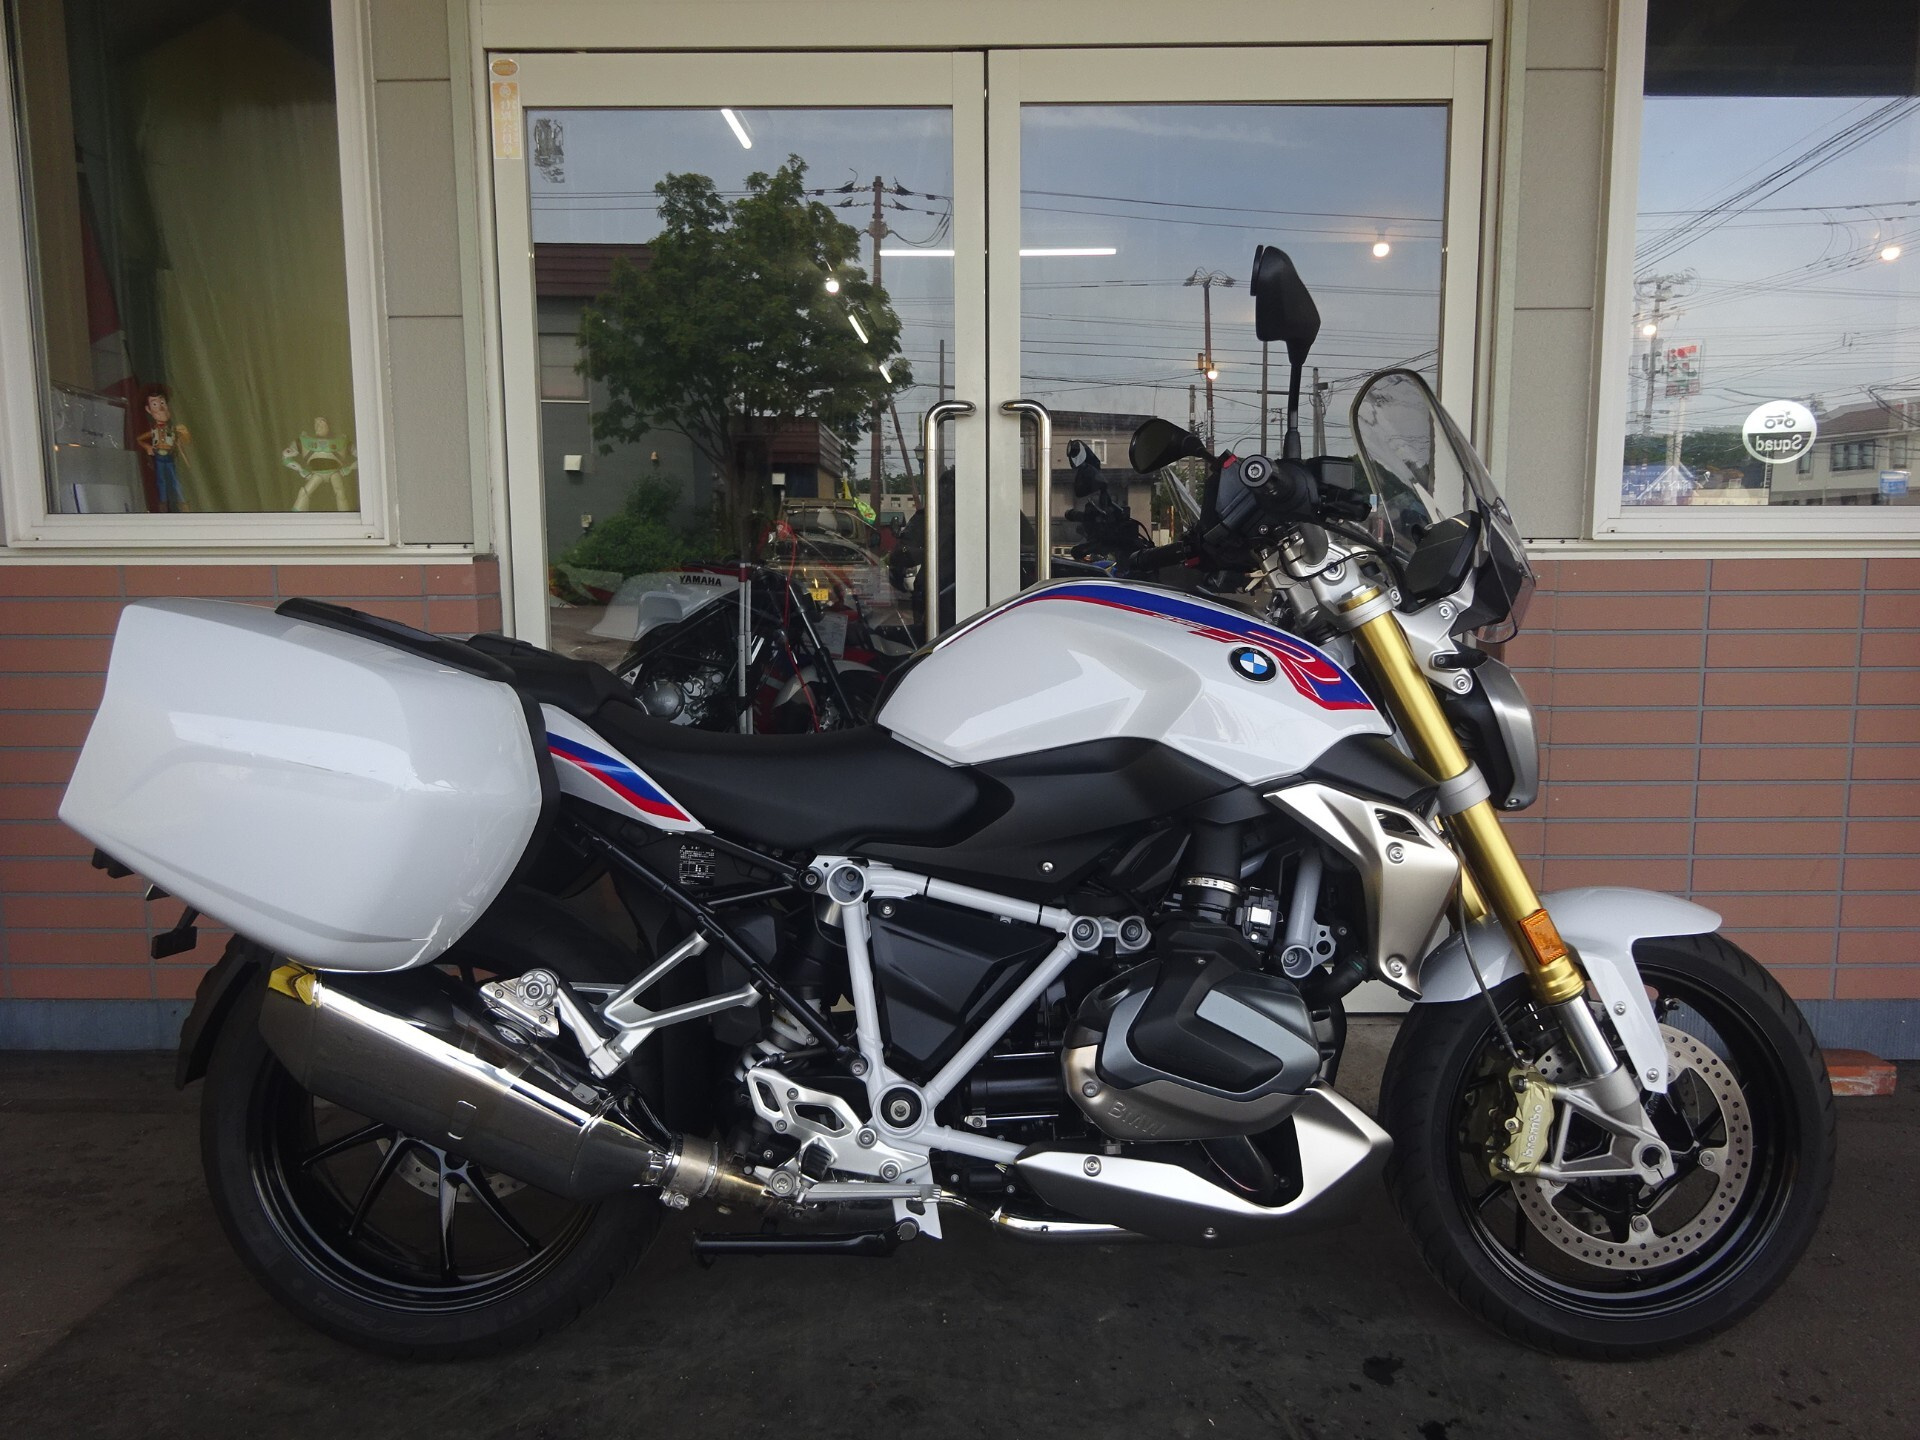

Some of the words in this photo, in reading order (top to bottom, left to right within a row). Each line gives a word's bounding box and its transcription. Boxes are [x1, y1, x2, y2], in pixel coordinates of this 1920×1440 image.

[679, 575, 722, 587] YAMAHA
[1107, 1101, 1166, 1137] BMW
[1523, 1104, 1543, 1158] brembo
